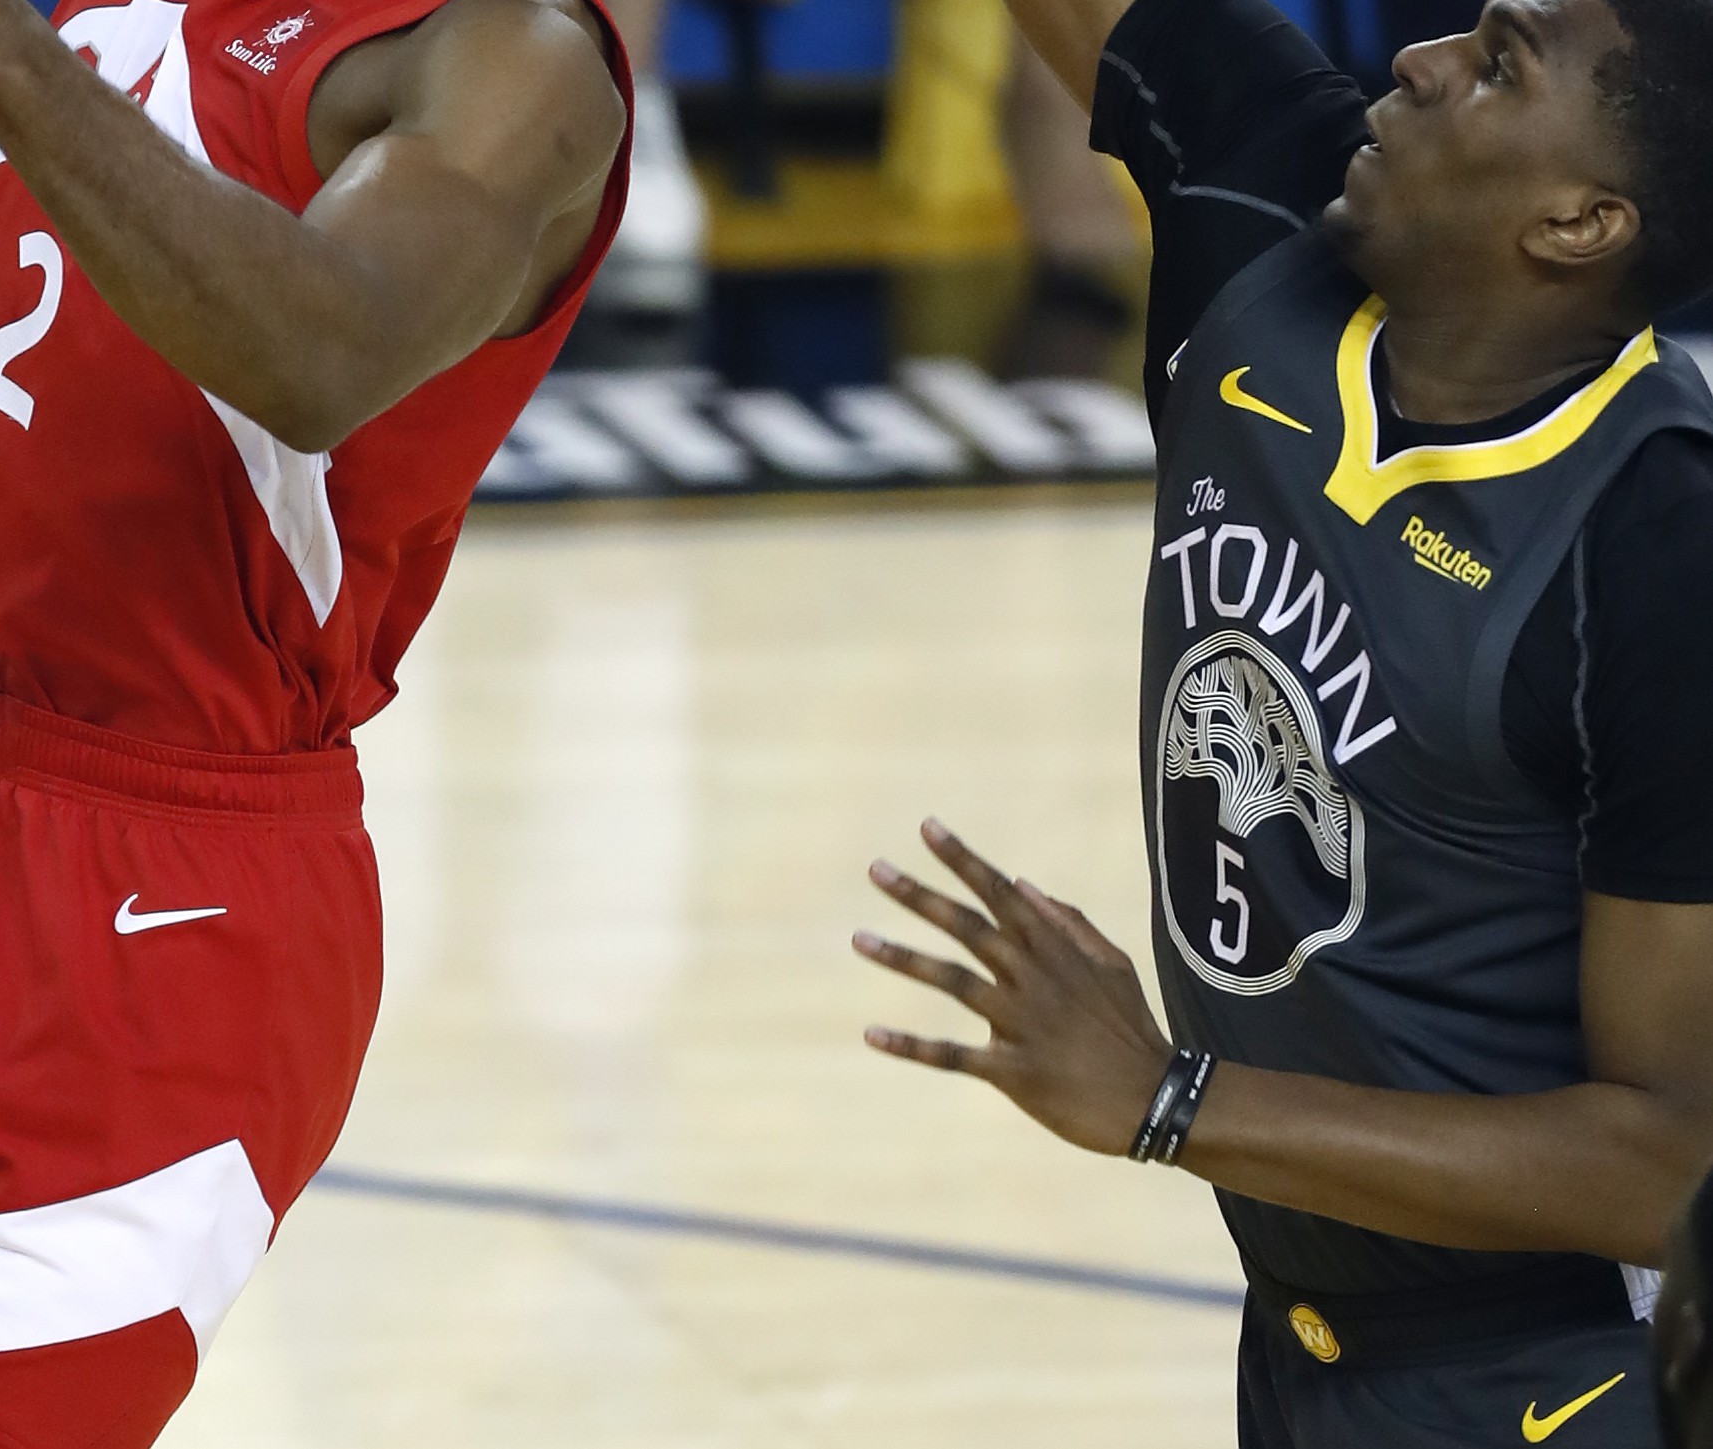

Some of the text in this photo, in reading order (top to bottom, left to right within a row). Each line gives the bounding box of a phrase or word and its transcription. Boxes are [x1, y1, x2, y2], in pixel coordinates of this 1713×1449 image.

[224, 39, 278, 76] Sun Life
[1186, 475, 1226, 518] The
[1400, 515, 1493, 592] Rakuten
[1160, 522, 1398, 766] TOWN
[1209, 840, 1250, 965] 5
